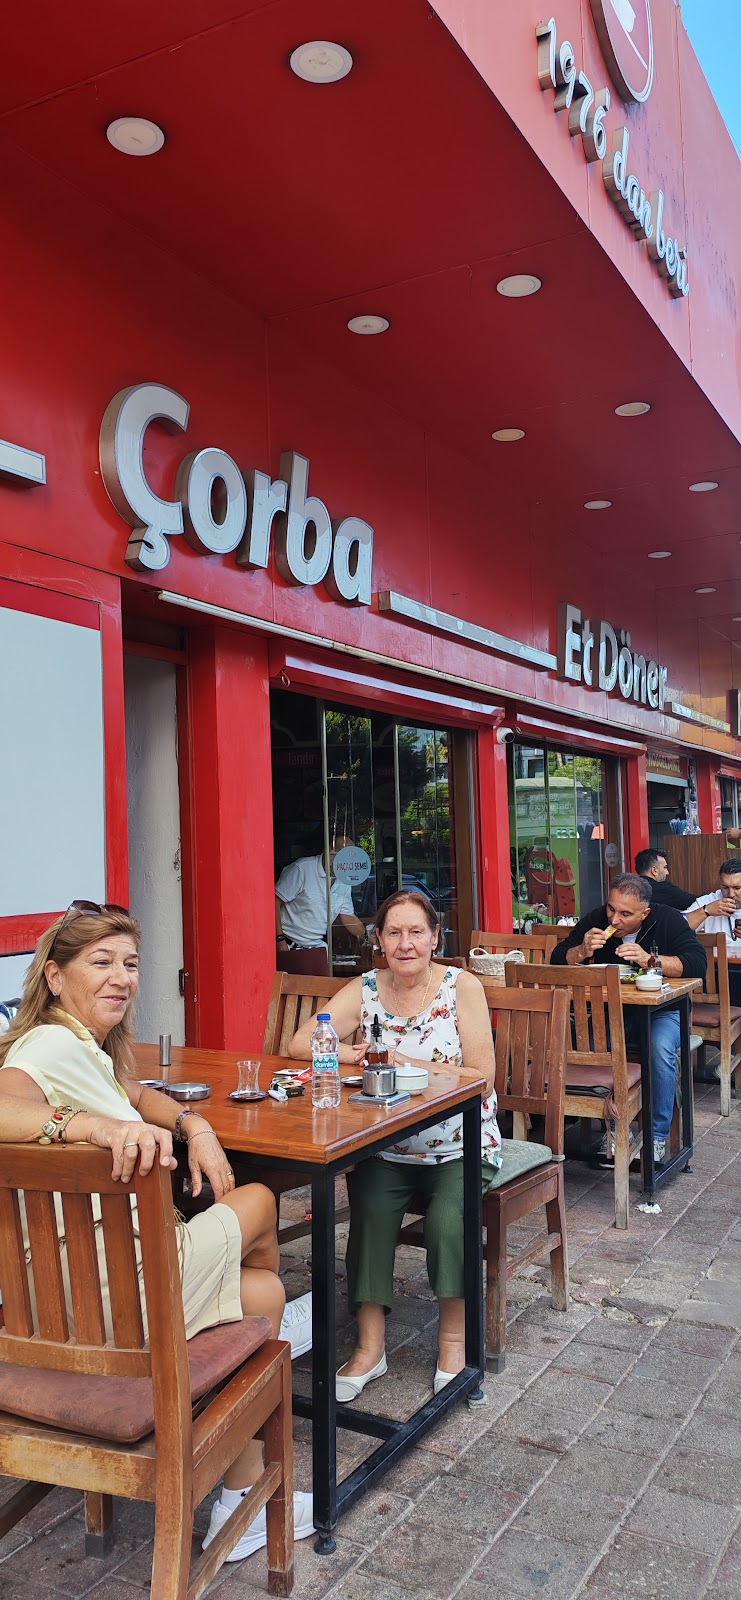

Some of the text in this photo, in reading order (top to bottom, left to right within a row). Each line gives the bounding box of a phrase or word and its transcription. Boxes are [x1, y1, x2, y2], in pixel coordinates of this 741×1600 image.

[536, 17, 688, 299] 1976 dan beri
[99, 381, 374, 606] Çorba
[558, 602, 667, 711] Et Döner
